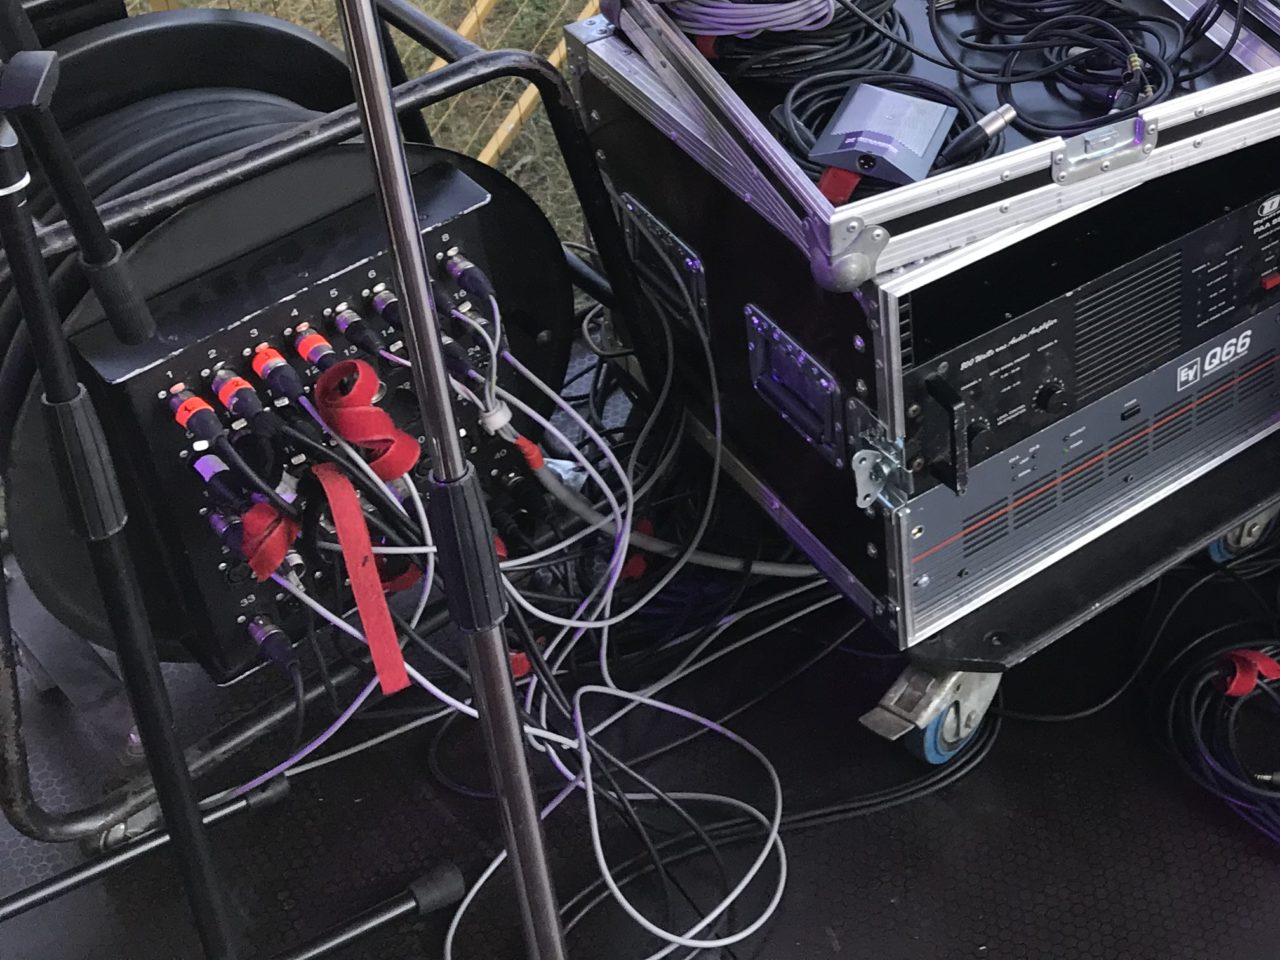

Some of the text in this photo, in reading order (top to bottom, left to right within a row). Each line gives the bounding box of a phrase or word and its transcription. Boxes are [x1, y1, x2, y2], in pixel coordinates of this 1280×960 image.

[367, 269, 377, 280] 6
[329, 288, 339, 299] 5
[290, 307, 300, 318] 4
[249, 328, 259, 339] 3
[380, 325, 396, 338] 14
[207, 348, 218, 360] 2
[1203, 329, 1252, 371] Q66
[166, 370, 174, 380] 1
[304, 365, 320, 377] 12
